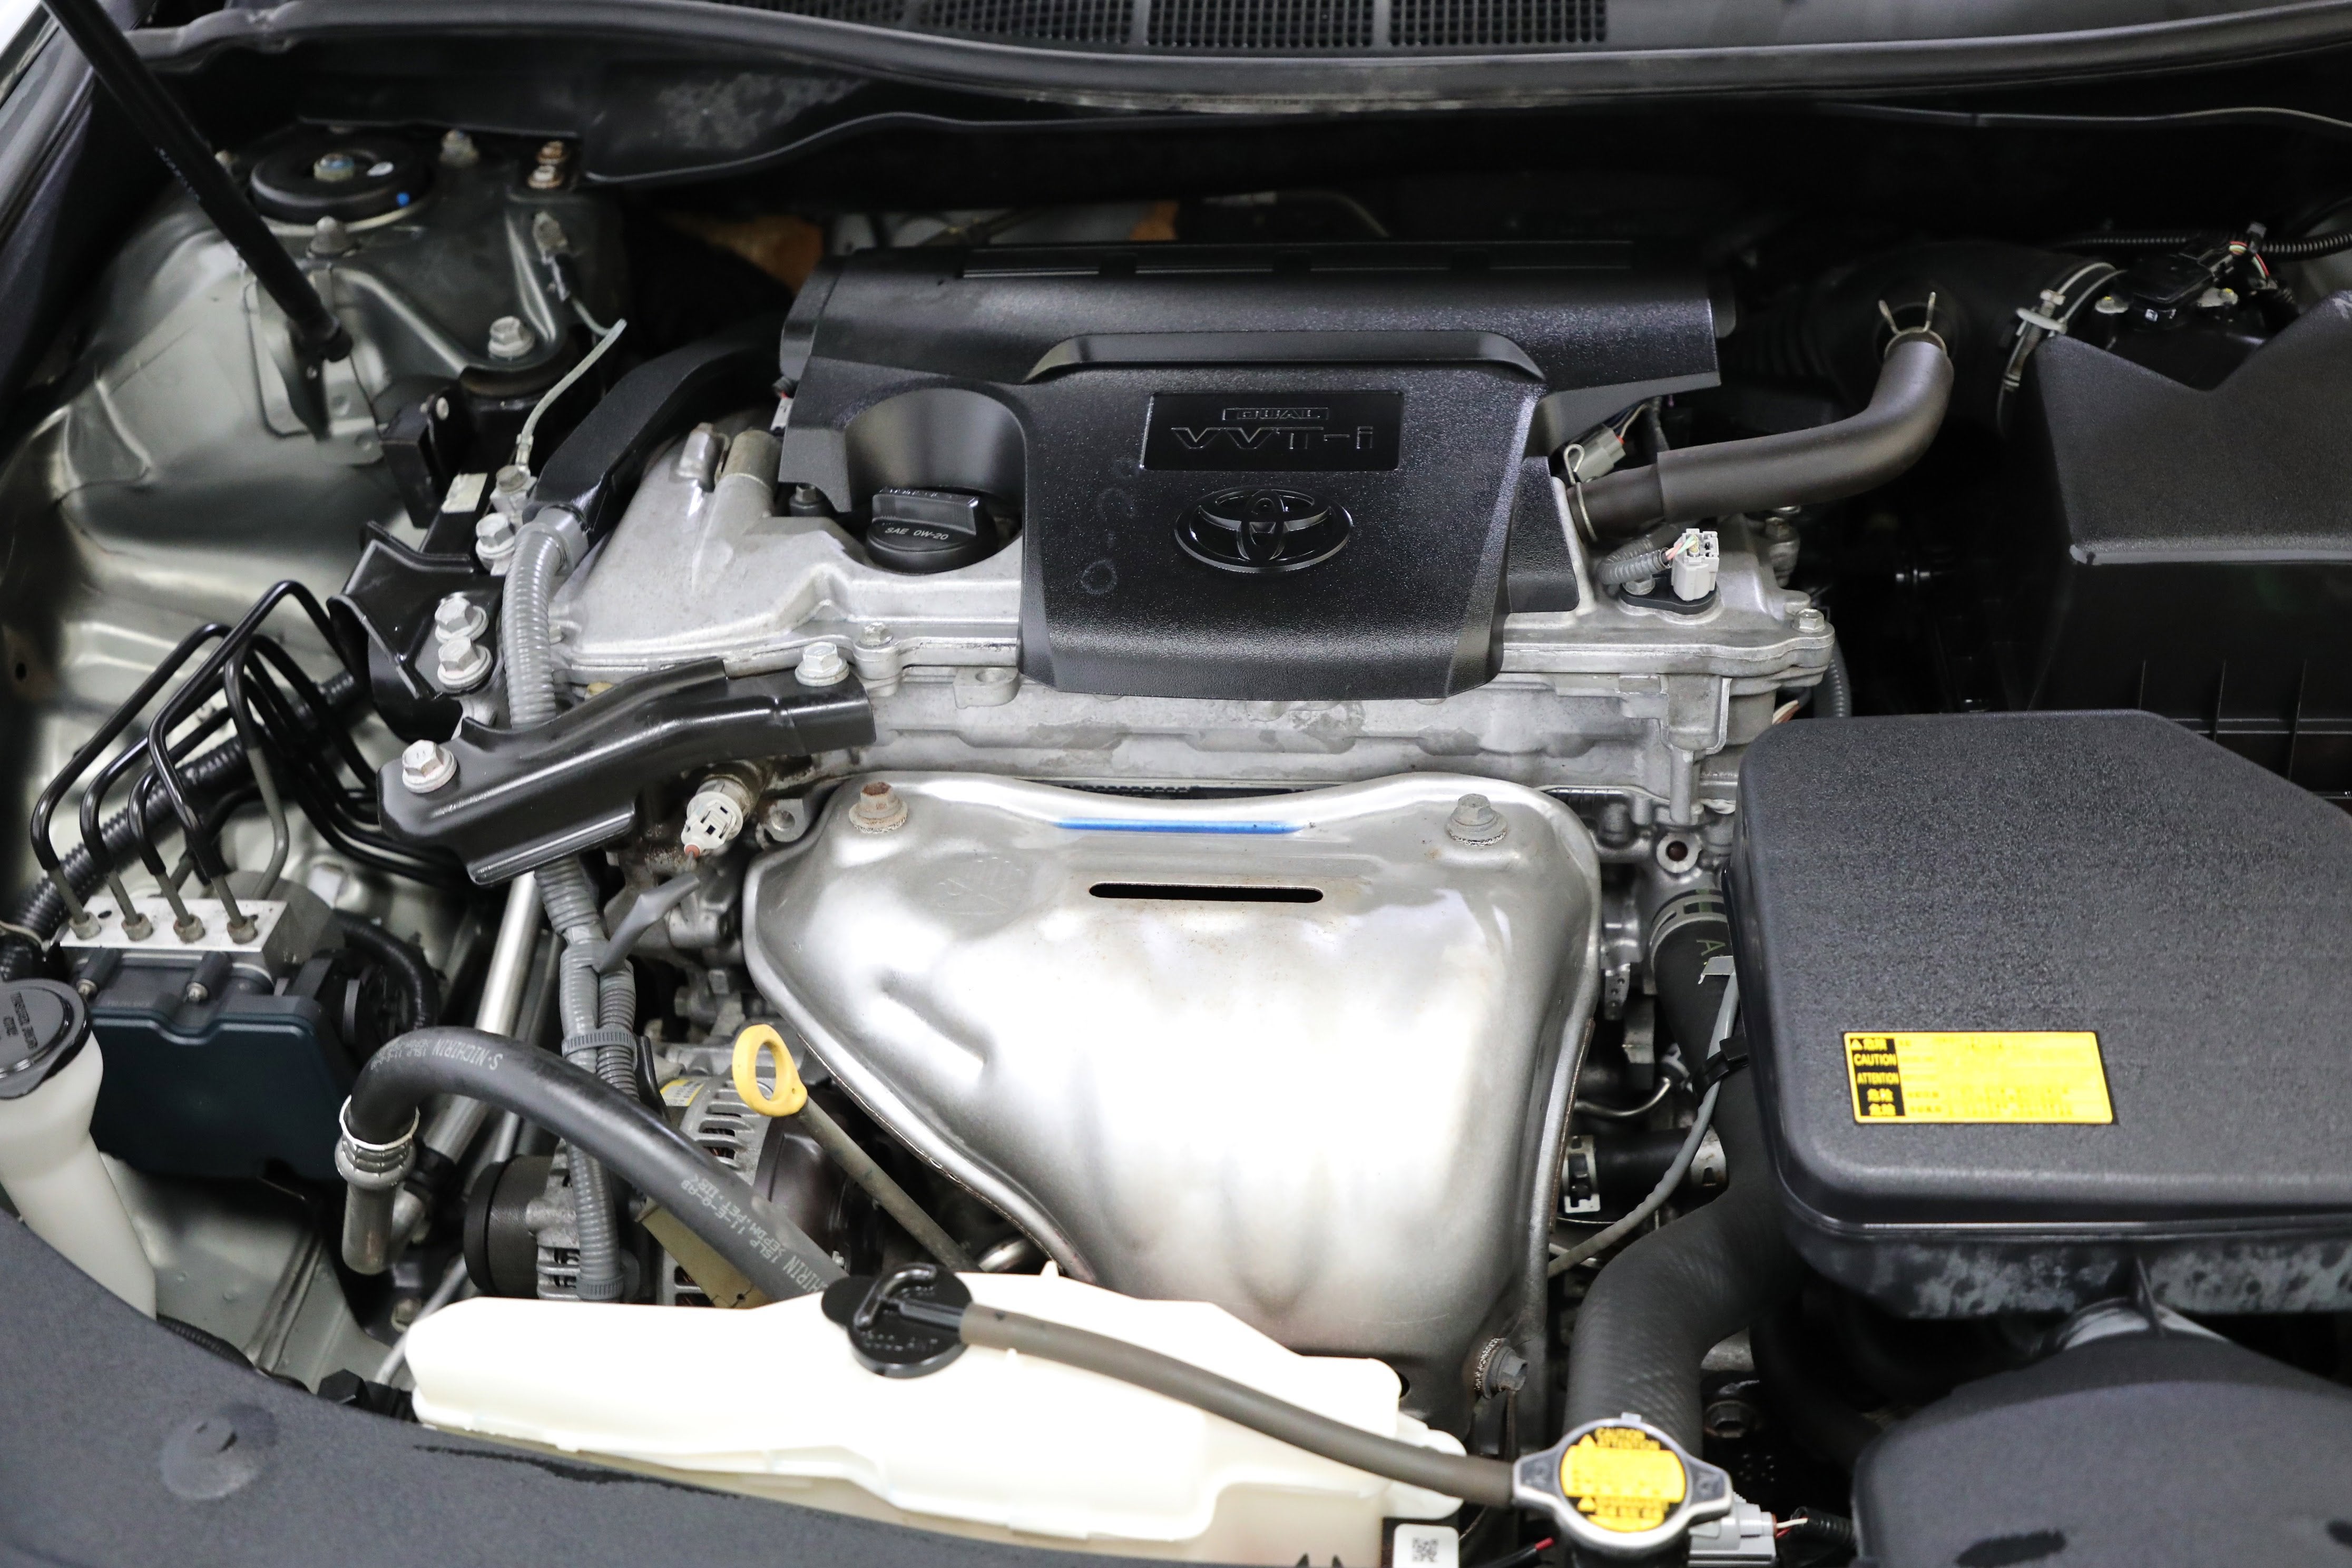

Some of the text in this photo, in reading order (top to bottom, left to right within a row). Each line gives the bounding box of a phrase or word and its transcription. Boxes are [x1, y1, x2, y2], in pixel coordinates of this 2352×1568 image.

[1240, 408, 1321, 419] DUAL
[1171, 426, 1375, 449] VVT-i
[913, 530, 949, 540] 0W-20
[1854, 1053, 1897, 1066] CAUTION
[1857, 1072, 1900, 1085] ATTENTION
[749, 1239, 779, 1264] 15LP
